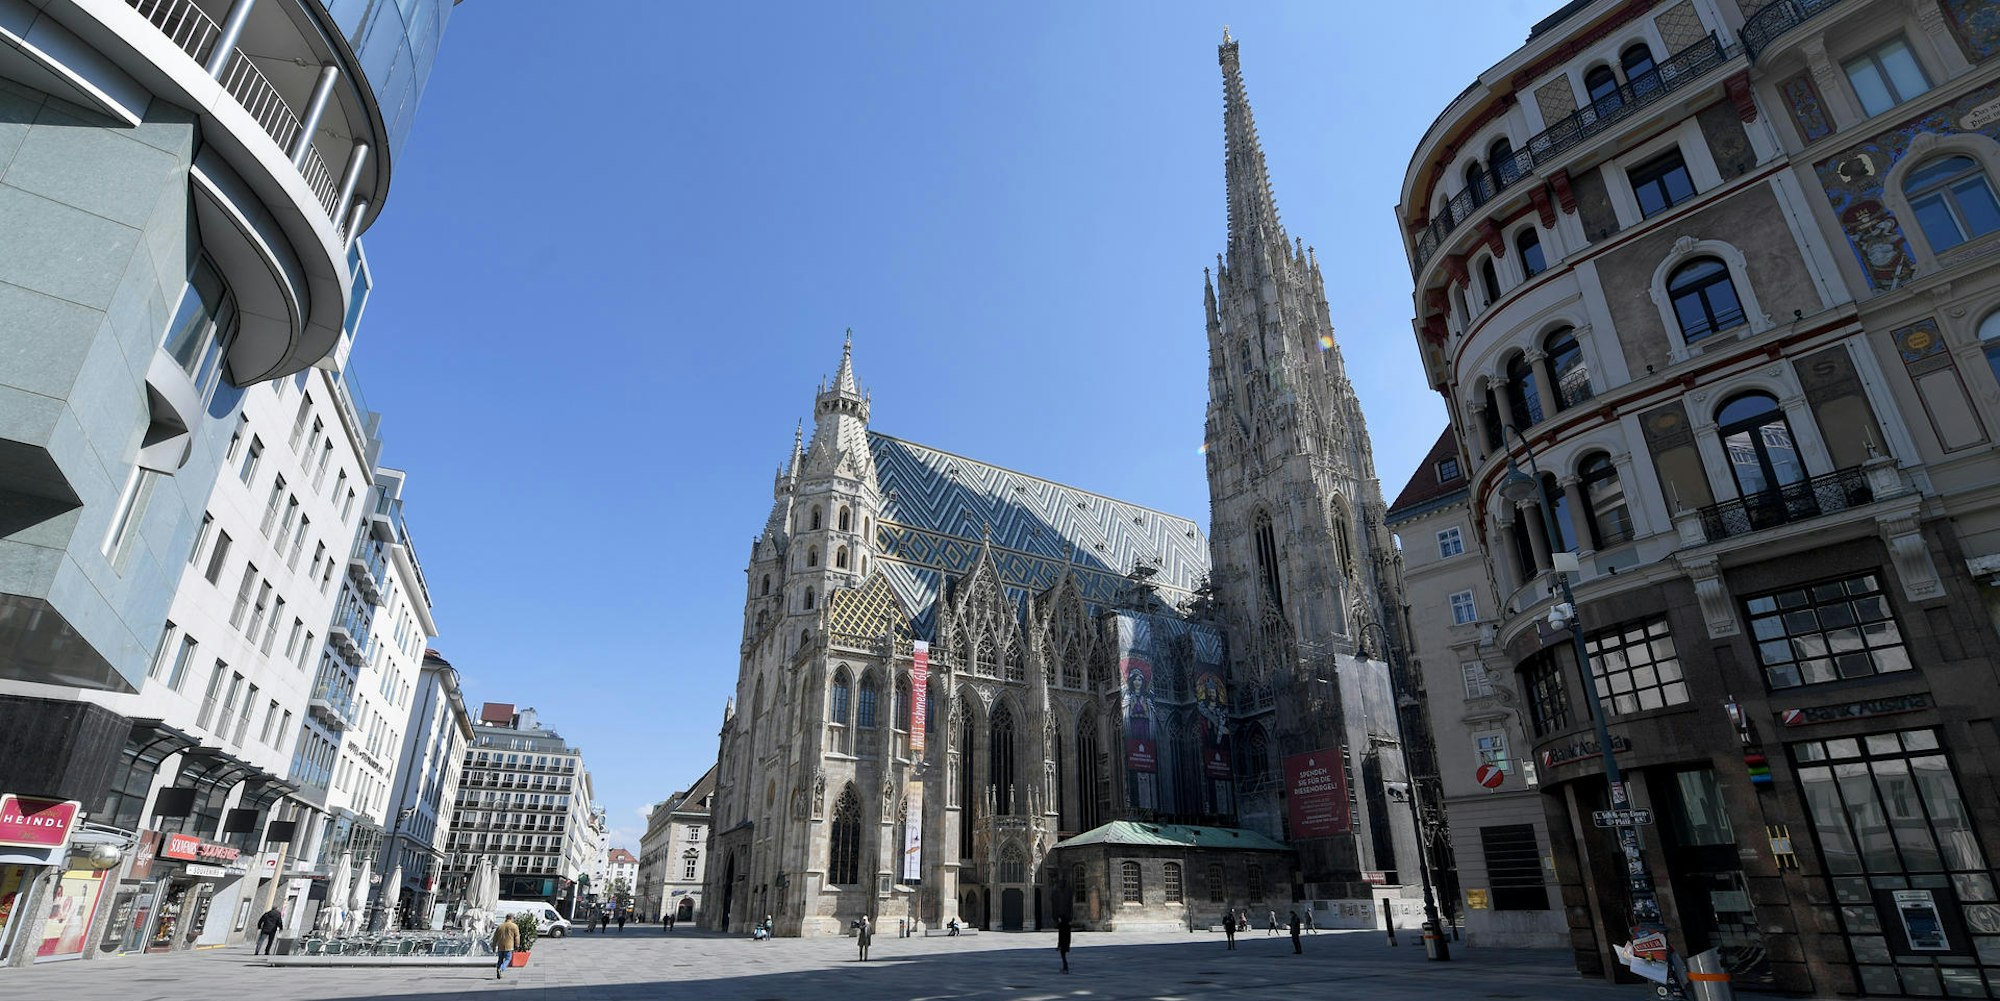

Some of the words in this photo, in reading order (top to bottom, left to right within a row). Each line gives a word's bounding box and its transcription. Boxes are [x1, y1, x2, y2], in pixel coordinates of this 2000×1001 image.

[912, 682, 926, 724] schmeckt
[1806, 704, 1854, 721] Bank
[1859, 697, 1926, 714] Austria
[911, 725, 924, 747] MUT
[1300, 768, 1327, 777] SPENDEN
[3, 814, 64, 828] HEINDL
[170, 838, 198, 854] SOUVENIRS
[201, 843, 240, 860] SOUVENIRS
